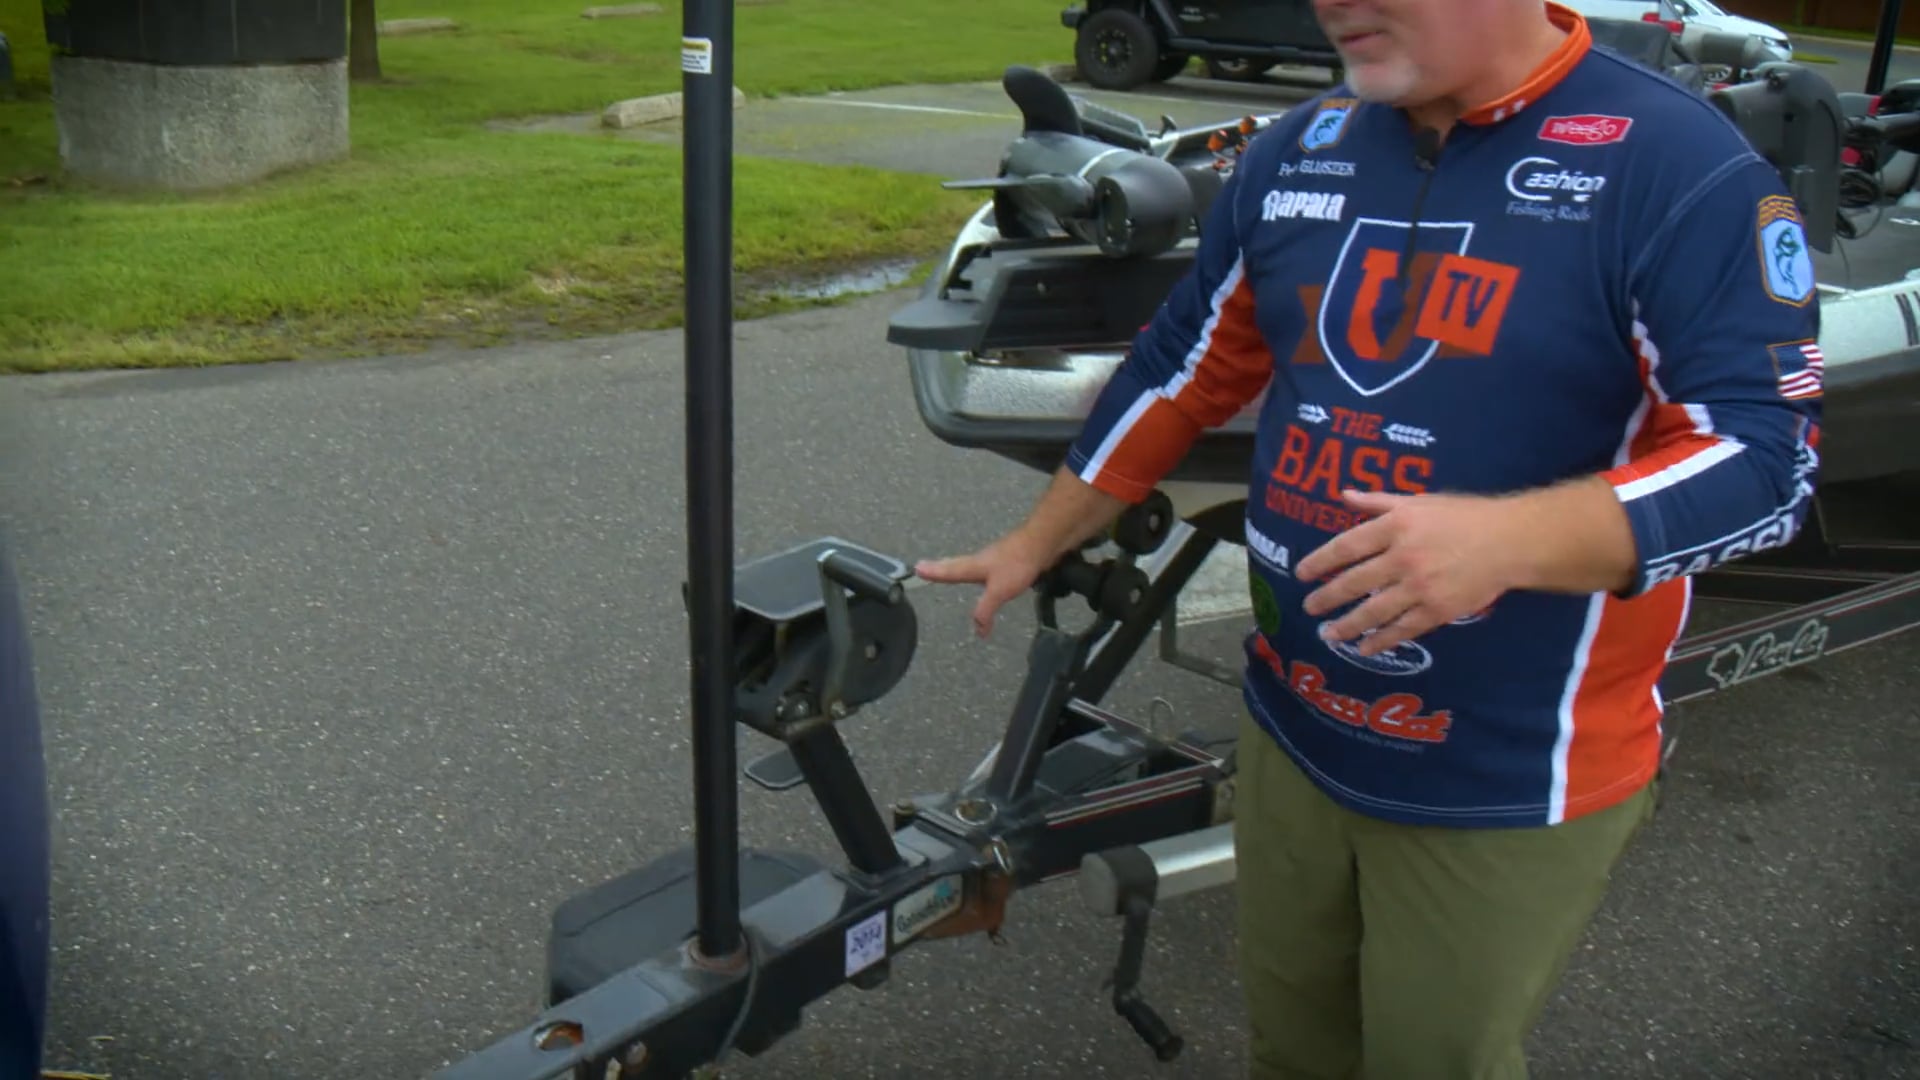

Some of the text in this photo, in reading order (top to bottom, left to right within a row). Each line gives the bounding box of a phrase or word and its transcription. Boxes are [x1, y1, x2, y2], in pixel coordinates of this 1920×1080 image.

[1505, 156, 1606, 202] Cashion
[1262, 189, 1346, 221] Rapala
[1439, 269, 1501, 331] TV
[1331, 406, 1384, 442] THE
[1271, 424, 1434, 500] BASS
